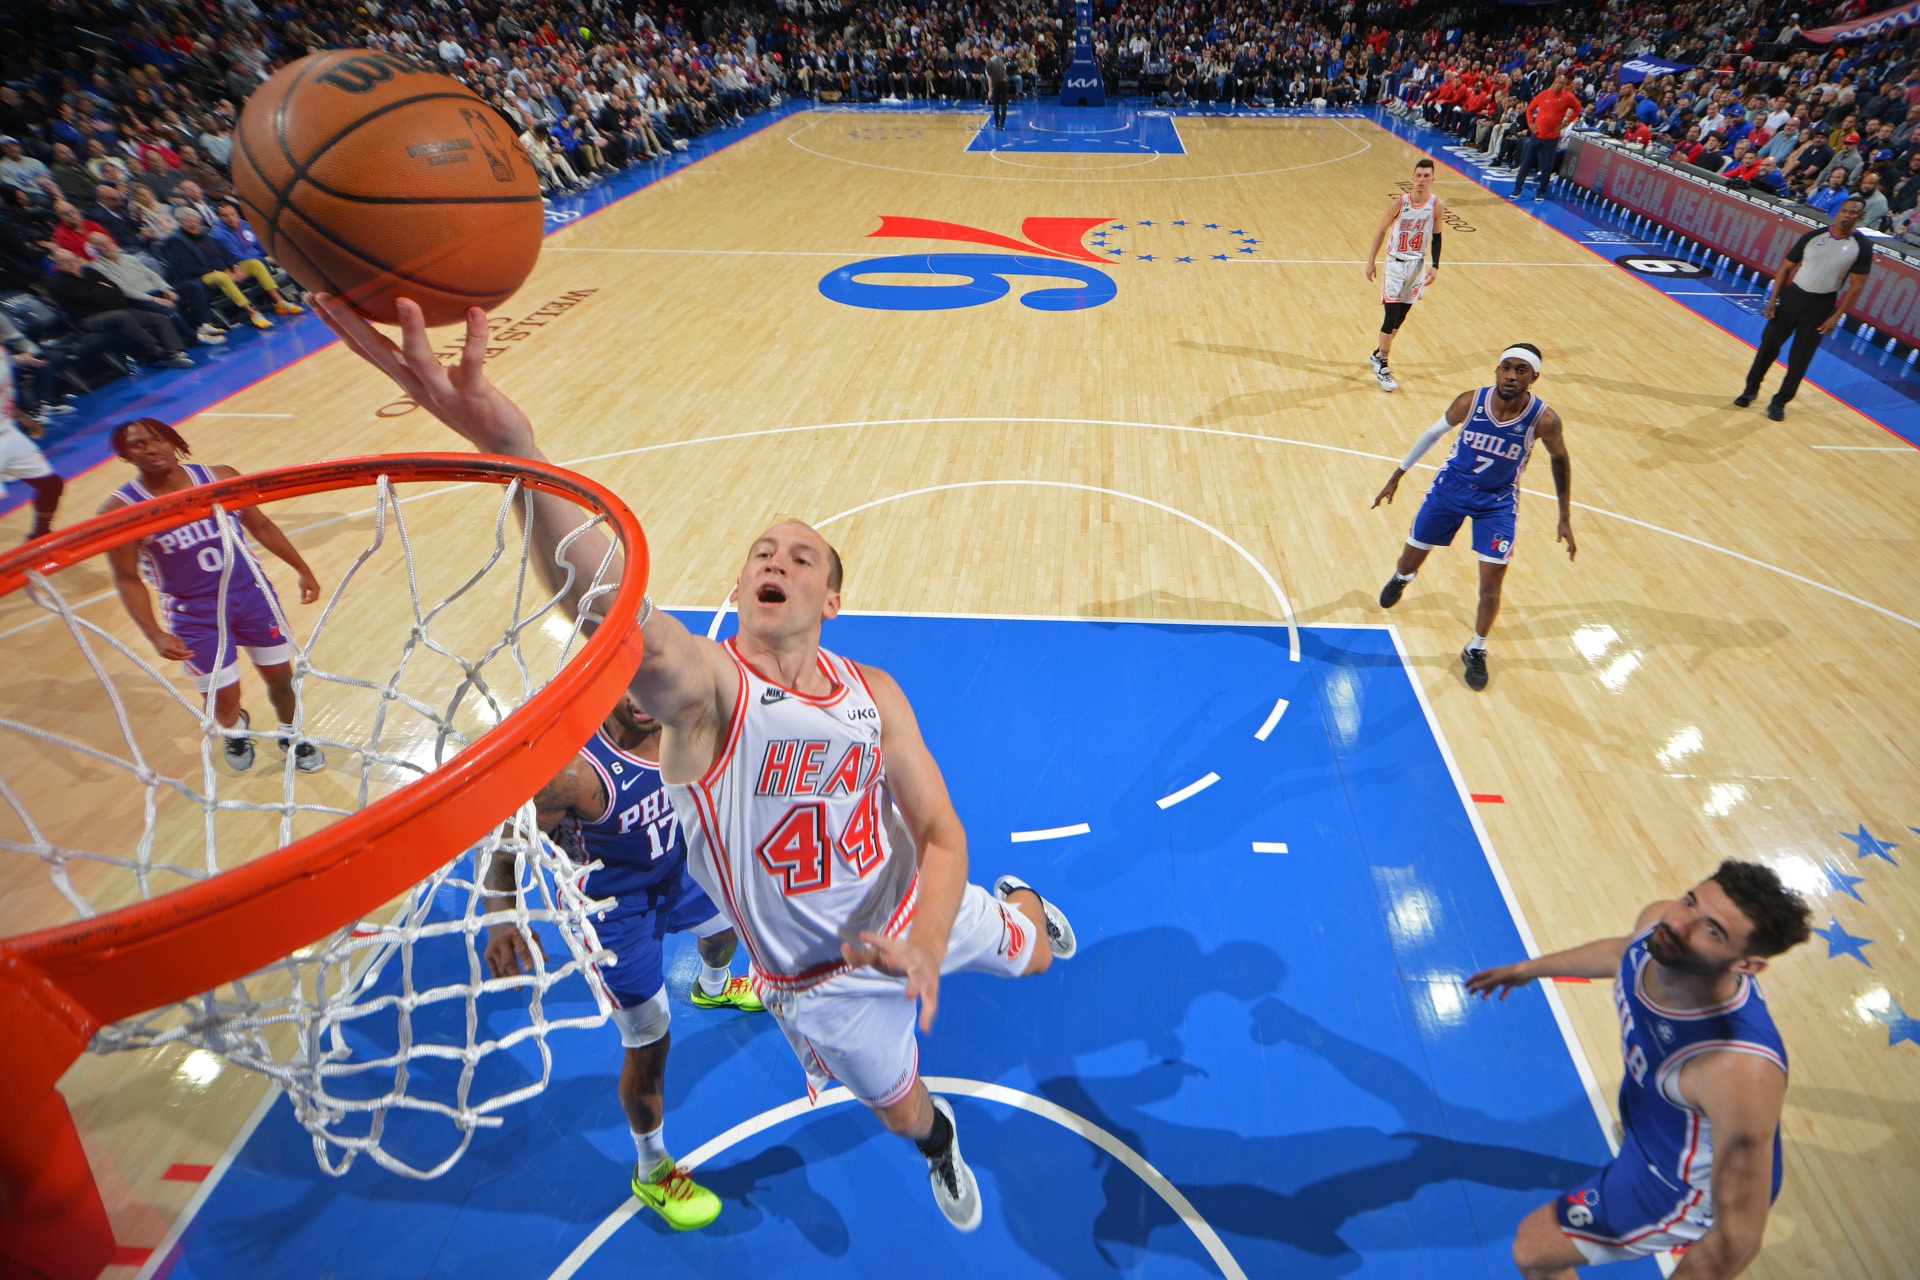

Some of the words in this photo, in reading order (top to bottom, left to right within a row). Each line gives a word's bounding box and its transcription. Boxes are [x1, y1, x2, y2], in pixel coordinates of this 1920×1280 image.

[1067, 78, 1098, 88] KIA
[1187, 111, 1366, 119] crypto.com
[1399, 218, 1428, 231] HEAT
[1667, 186, 1767, 261] HEALTHY.
[1398, 232, 1424, 252] 14
[494, 288, 600, 342] WELLS
[1476, 405, 1484, 414] 6
[1463, 429, 1523, 461] PHILA
[1473, 454, 1494, 474] 7
[1490, 539, 1510, 553] 76
[196, 546, 224, 572] 0
[611, 761, 624, 775] 6
[646, 810, 679, 861] 17
[755, 778, 884, 897] 44
